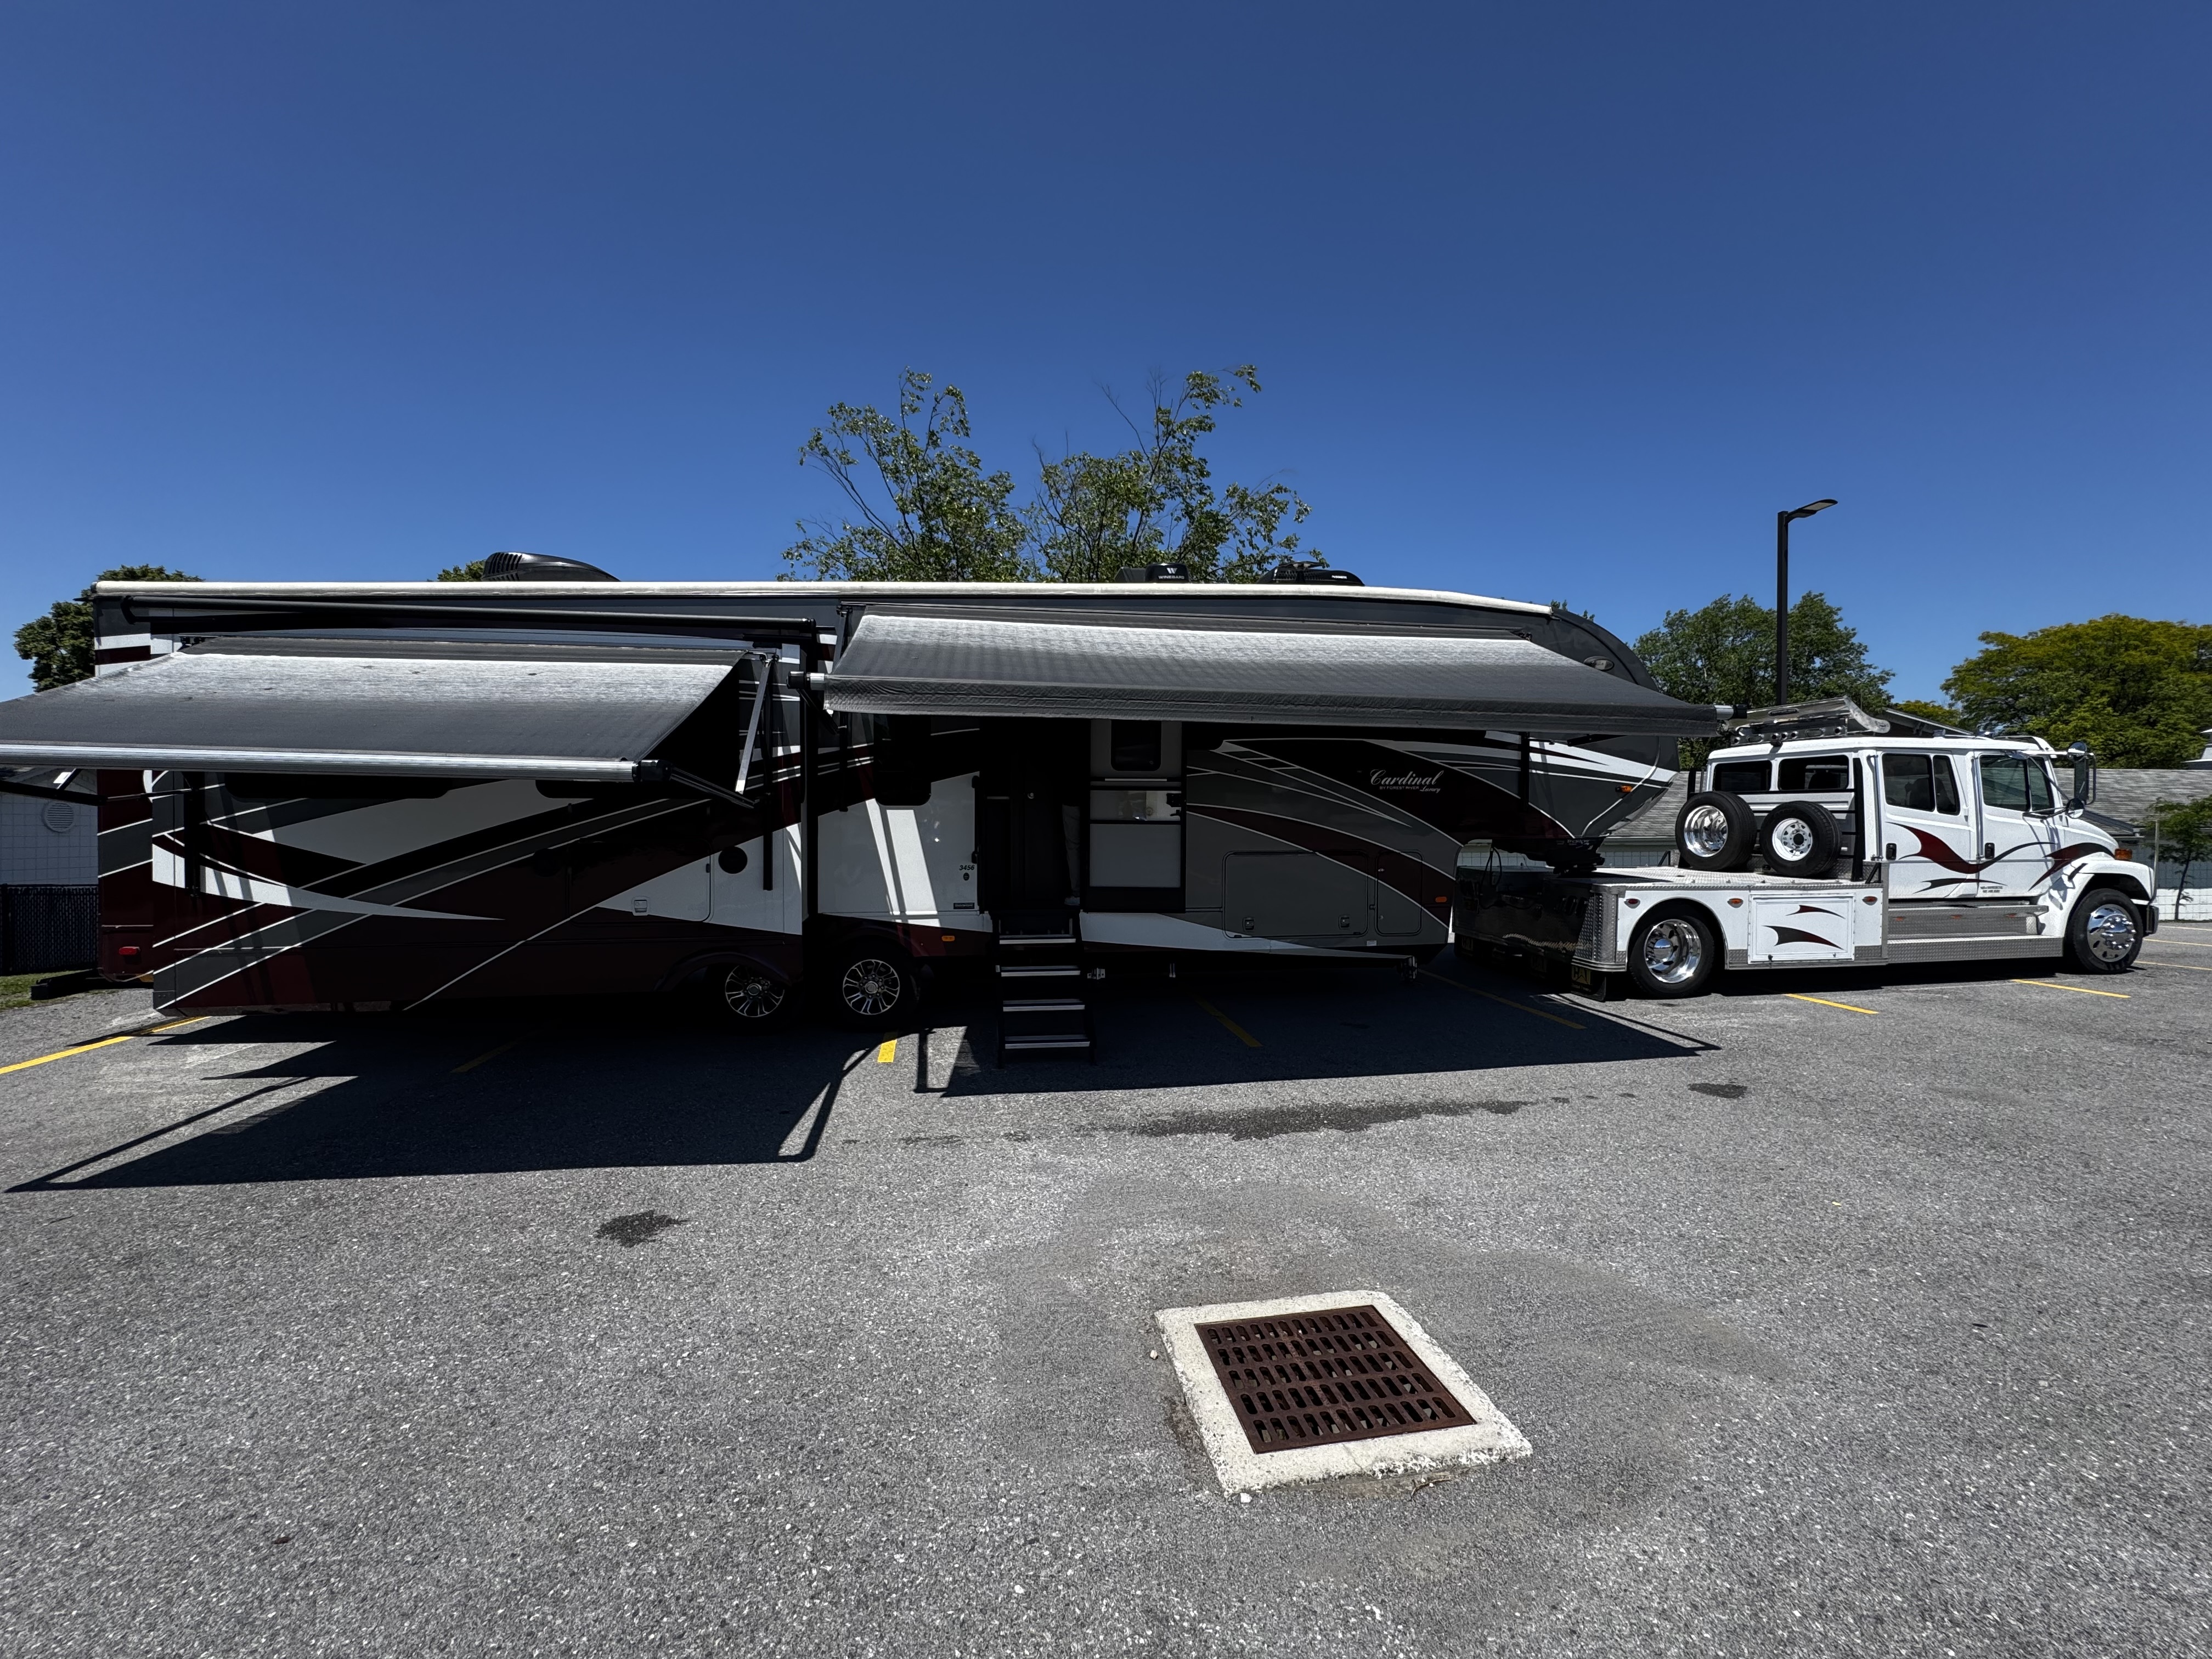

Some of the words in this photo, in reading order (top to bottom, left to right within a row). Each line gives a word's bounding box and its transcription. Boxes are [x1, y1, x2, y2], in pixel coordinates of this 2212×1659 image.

[1370, 769, 1444, 785] Cardinal
[1419, 785, 1441, 793] Luxury
[1571, 966, 1592, 985] CAT
